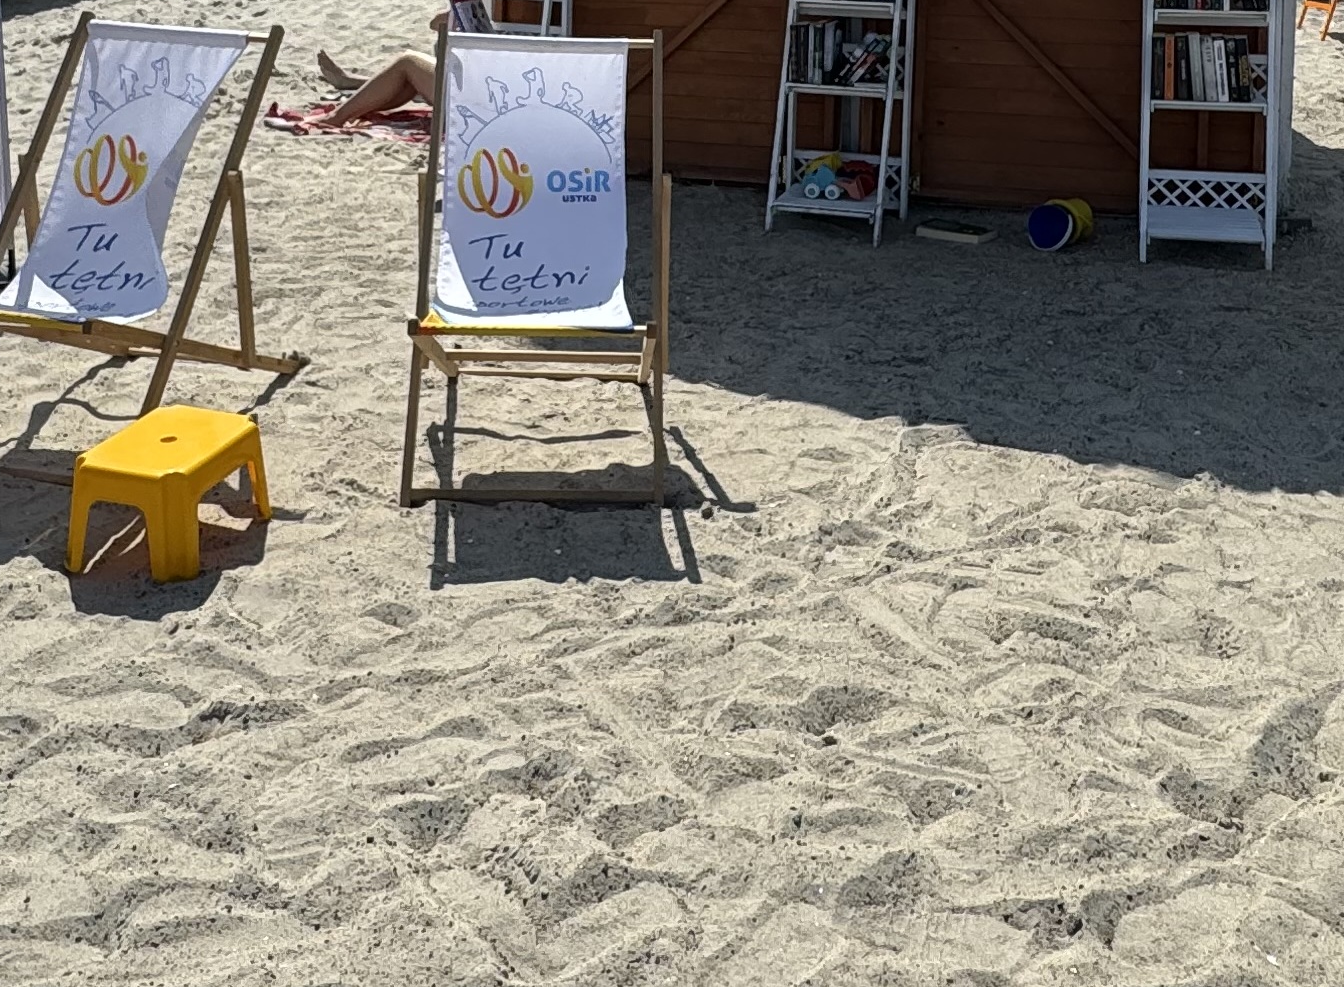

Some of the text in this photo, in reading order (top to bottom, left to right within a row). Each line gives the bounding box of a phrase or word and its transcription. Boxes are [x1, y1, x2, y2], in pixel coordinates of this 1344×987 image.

[67, 223, 119, 252] Tu
[468, 233, 524, 260] Tu
[471, 263, 590, 295] tętni
[474, 296, 570, 307] portowe
